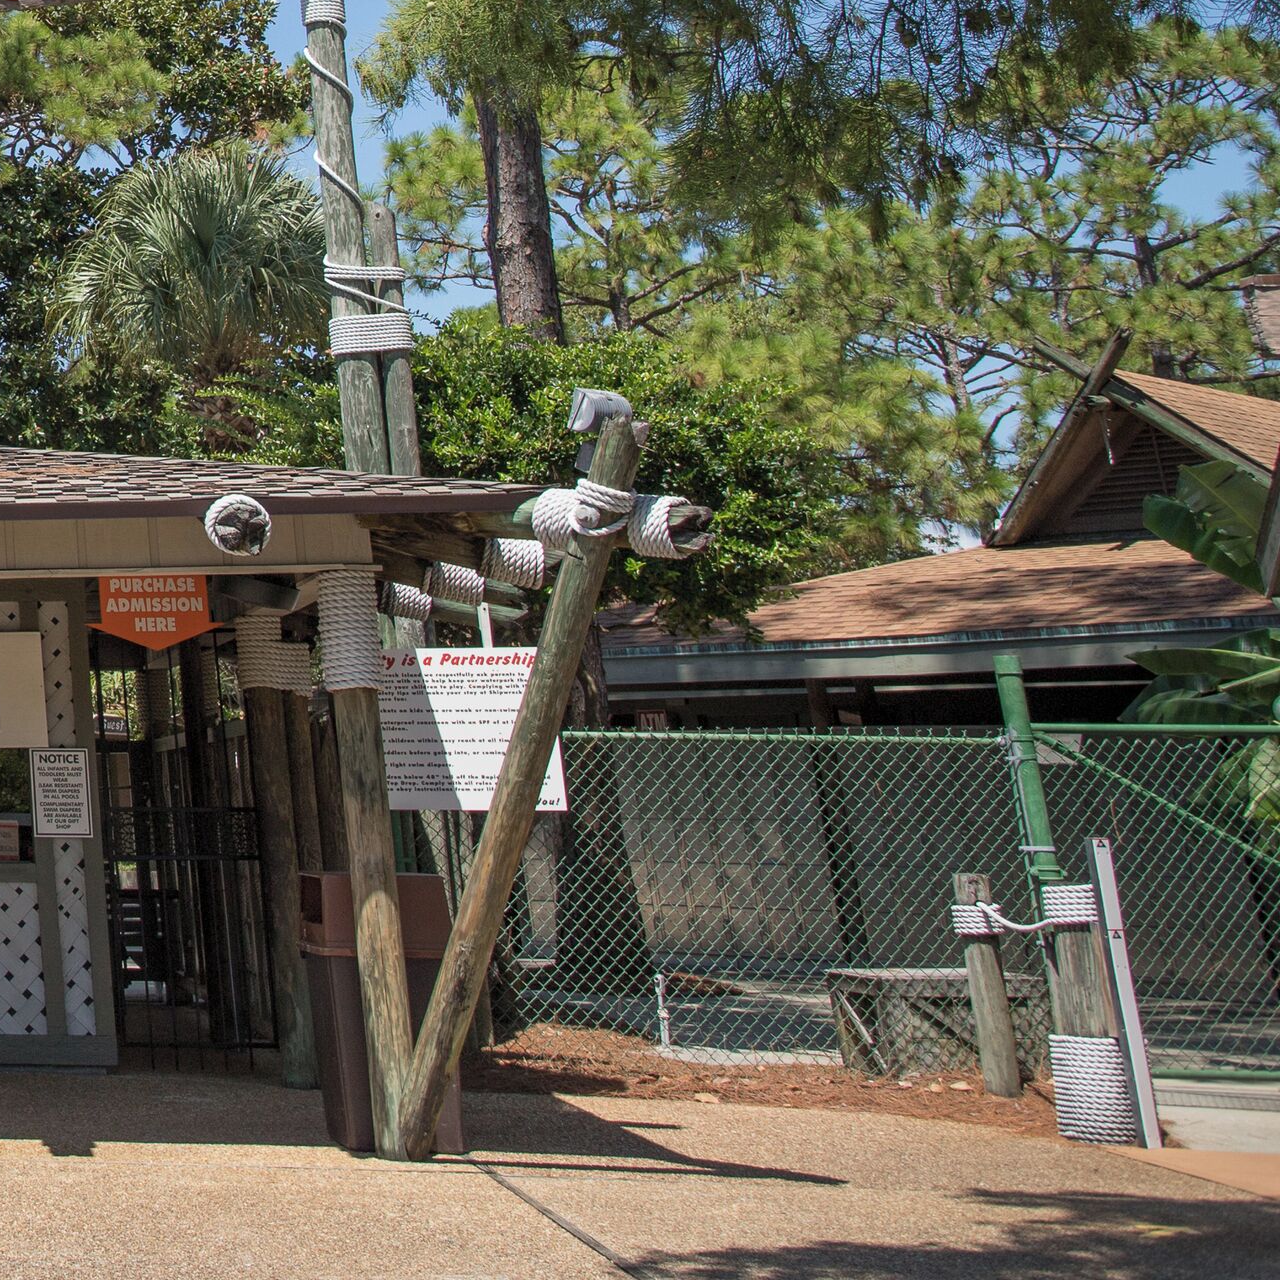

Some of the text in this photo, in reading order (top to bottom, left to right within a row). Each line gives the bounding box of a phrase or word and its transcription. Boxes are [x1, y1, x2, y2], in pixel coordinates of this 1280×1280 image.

[110, 578, 195, 592] PURCHASE
[106, 597, 203, 612] ADMISSION
[135, 618, 176, 631] HERE
[402, 654, 416, 666] is
[423, 656, 432, 666] a
[440, 653, 535, 668] Partnership
[39, 754, 79, 763] NOTICE
